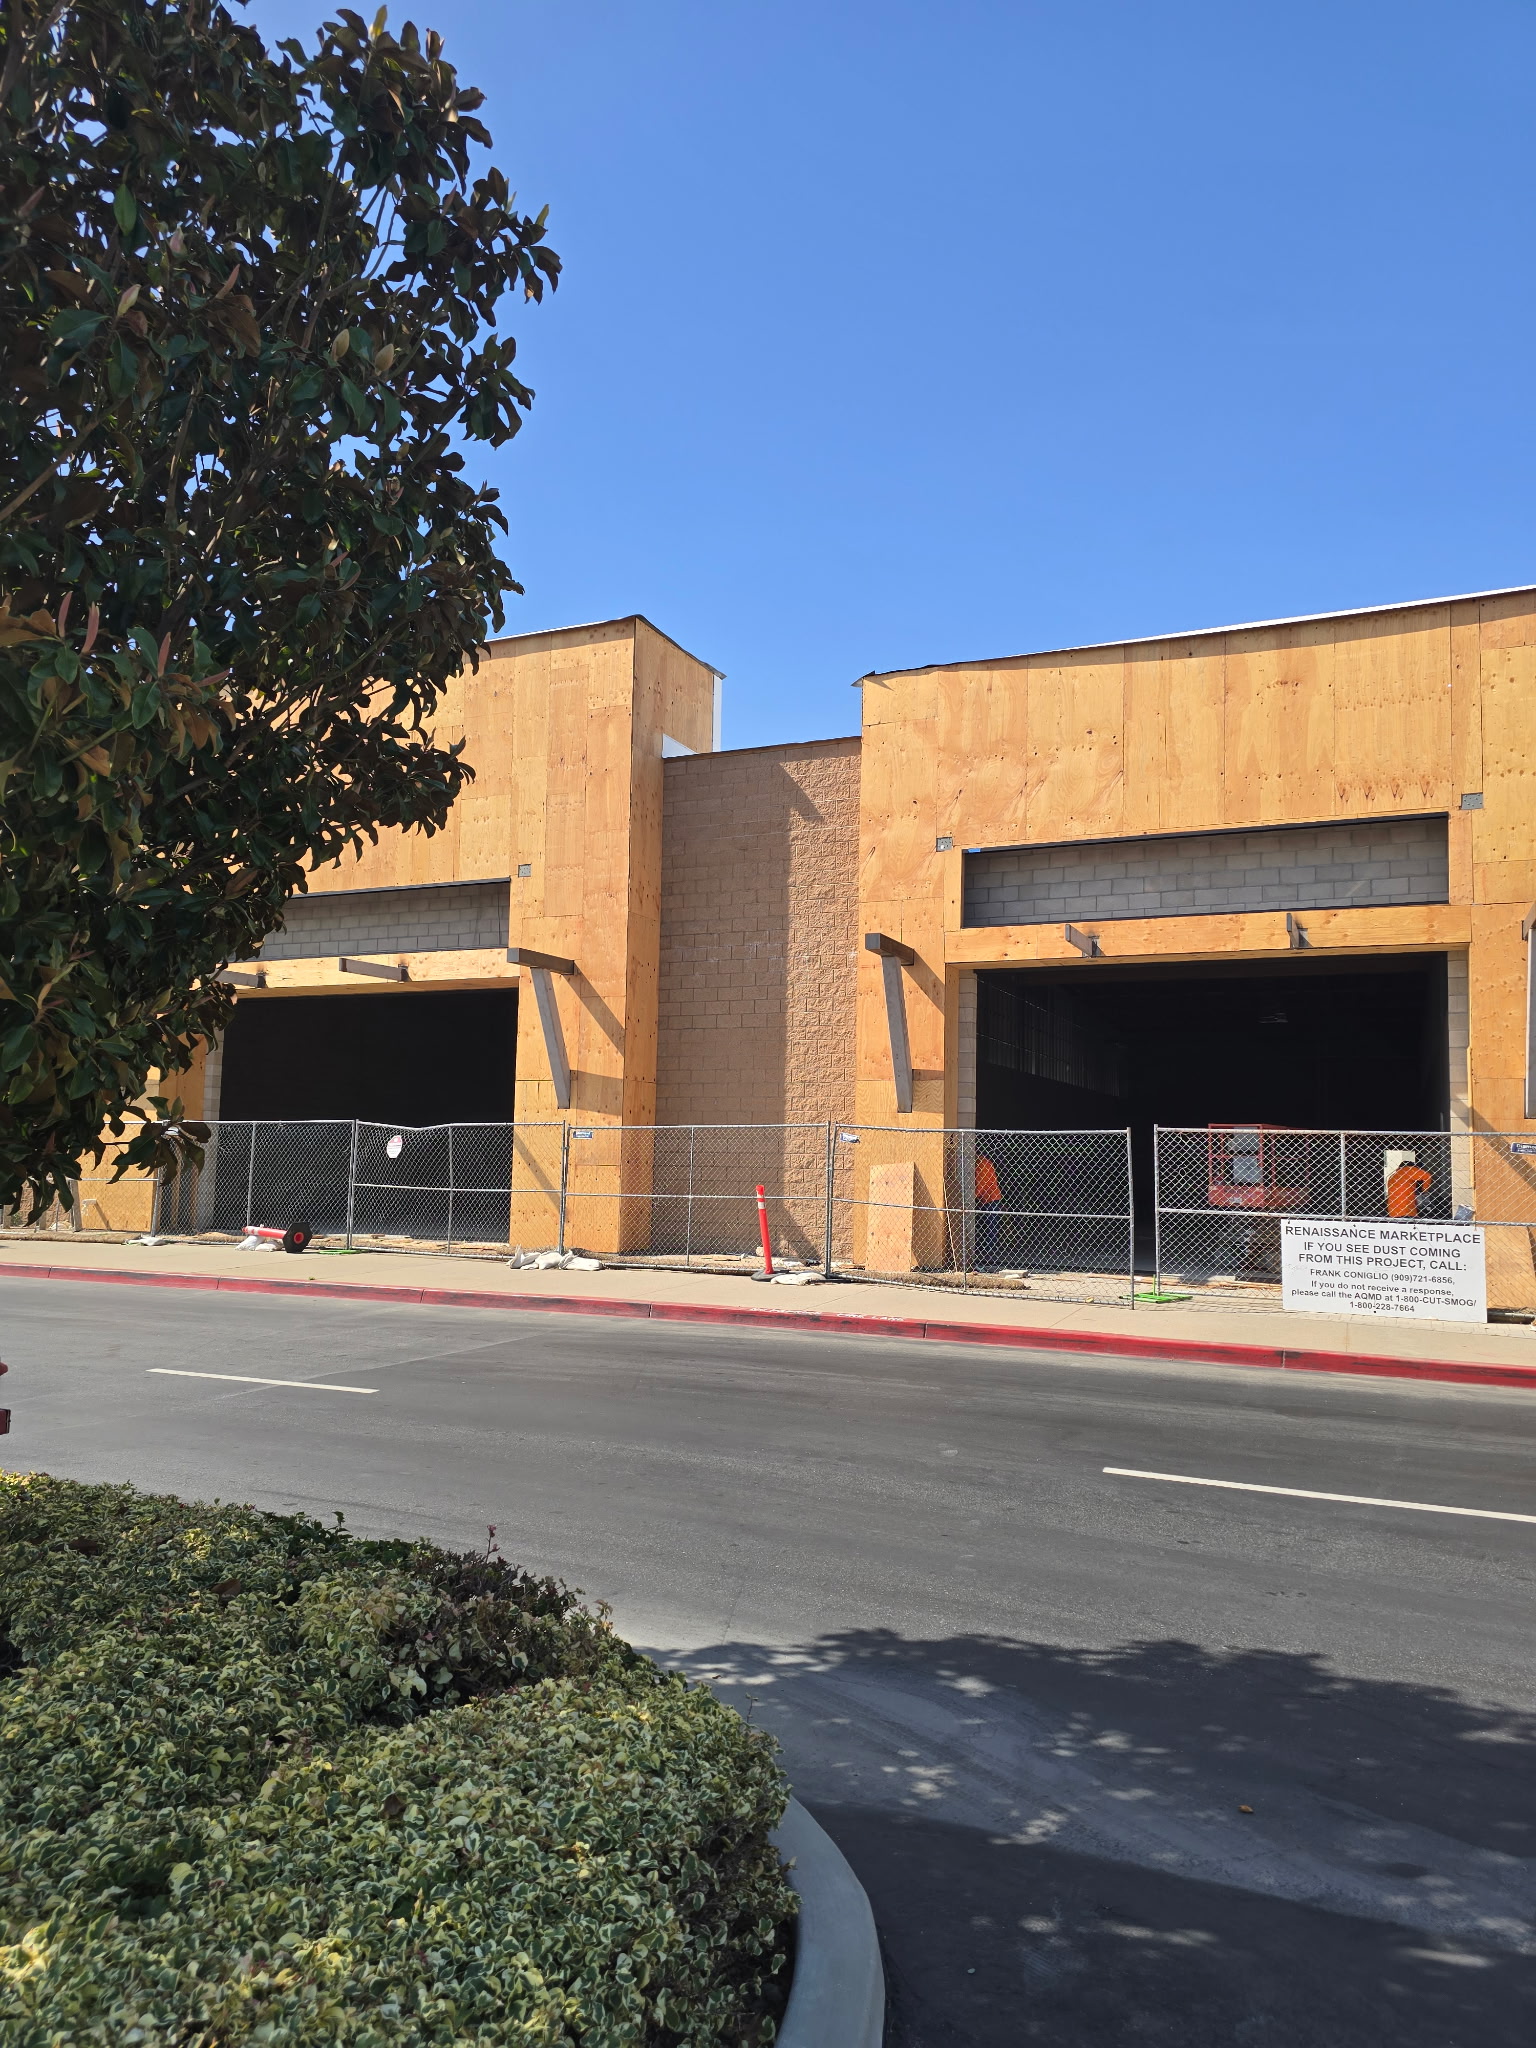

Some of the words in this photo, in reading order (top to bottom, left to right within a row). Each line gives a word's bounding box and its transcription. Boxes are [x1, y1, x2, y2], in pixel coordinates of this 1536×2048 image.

[1285, 1226, 1376, 1239] RENAISSANCE
[1380, 1230, 1480, 1243] MARKETPLACE
[1304, 1242, 1314, 1250] IF
[1317, 1242, 1342, 1251] YOU
[1346, 1244, 1369, 1253] SEE
[1374, 1245, 1406, 1255] DUST
[1410, 1247, 1460, 1258] COMING
[1299, 1253, 1332, 1263] FROM
[1336, 1255, 1362, 1265] THIS
[1367, 1257, 1426, 1270] PROJECT,
[1430, 1260, 1466, 1271] CALL:
[1310, 1269, 1341, 1277] FRANK
[1343, 1271, 1388, 1280] CONIGLIO
[1321, 1290, 1336, 1298] call
[1354, 1292, 1382, 1301] AQMD
[1395, 1295, 1477, 1307] 1-800-CUT-SMOG/
[1409, 1287, 1454, 1296] response,
